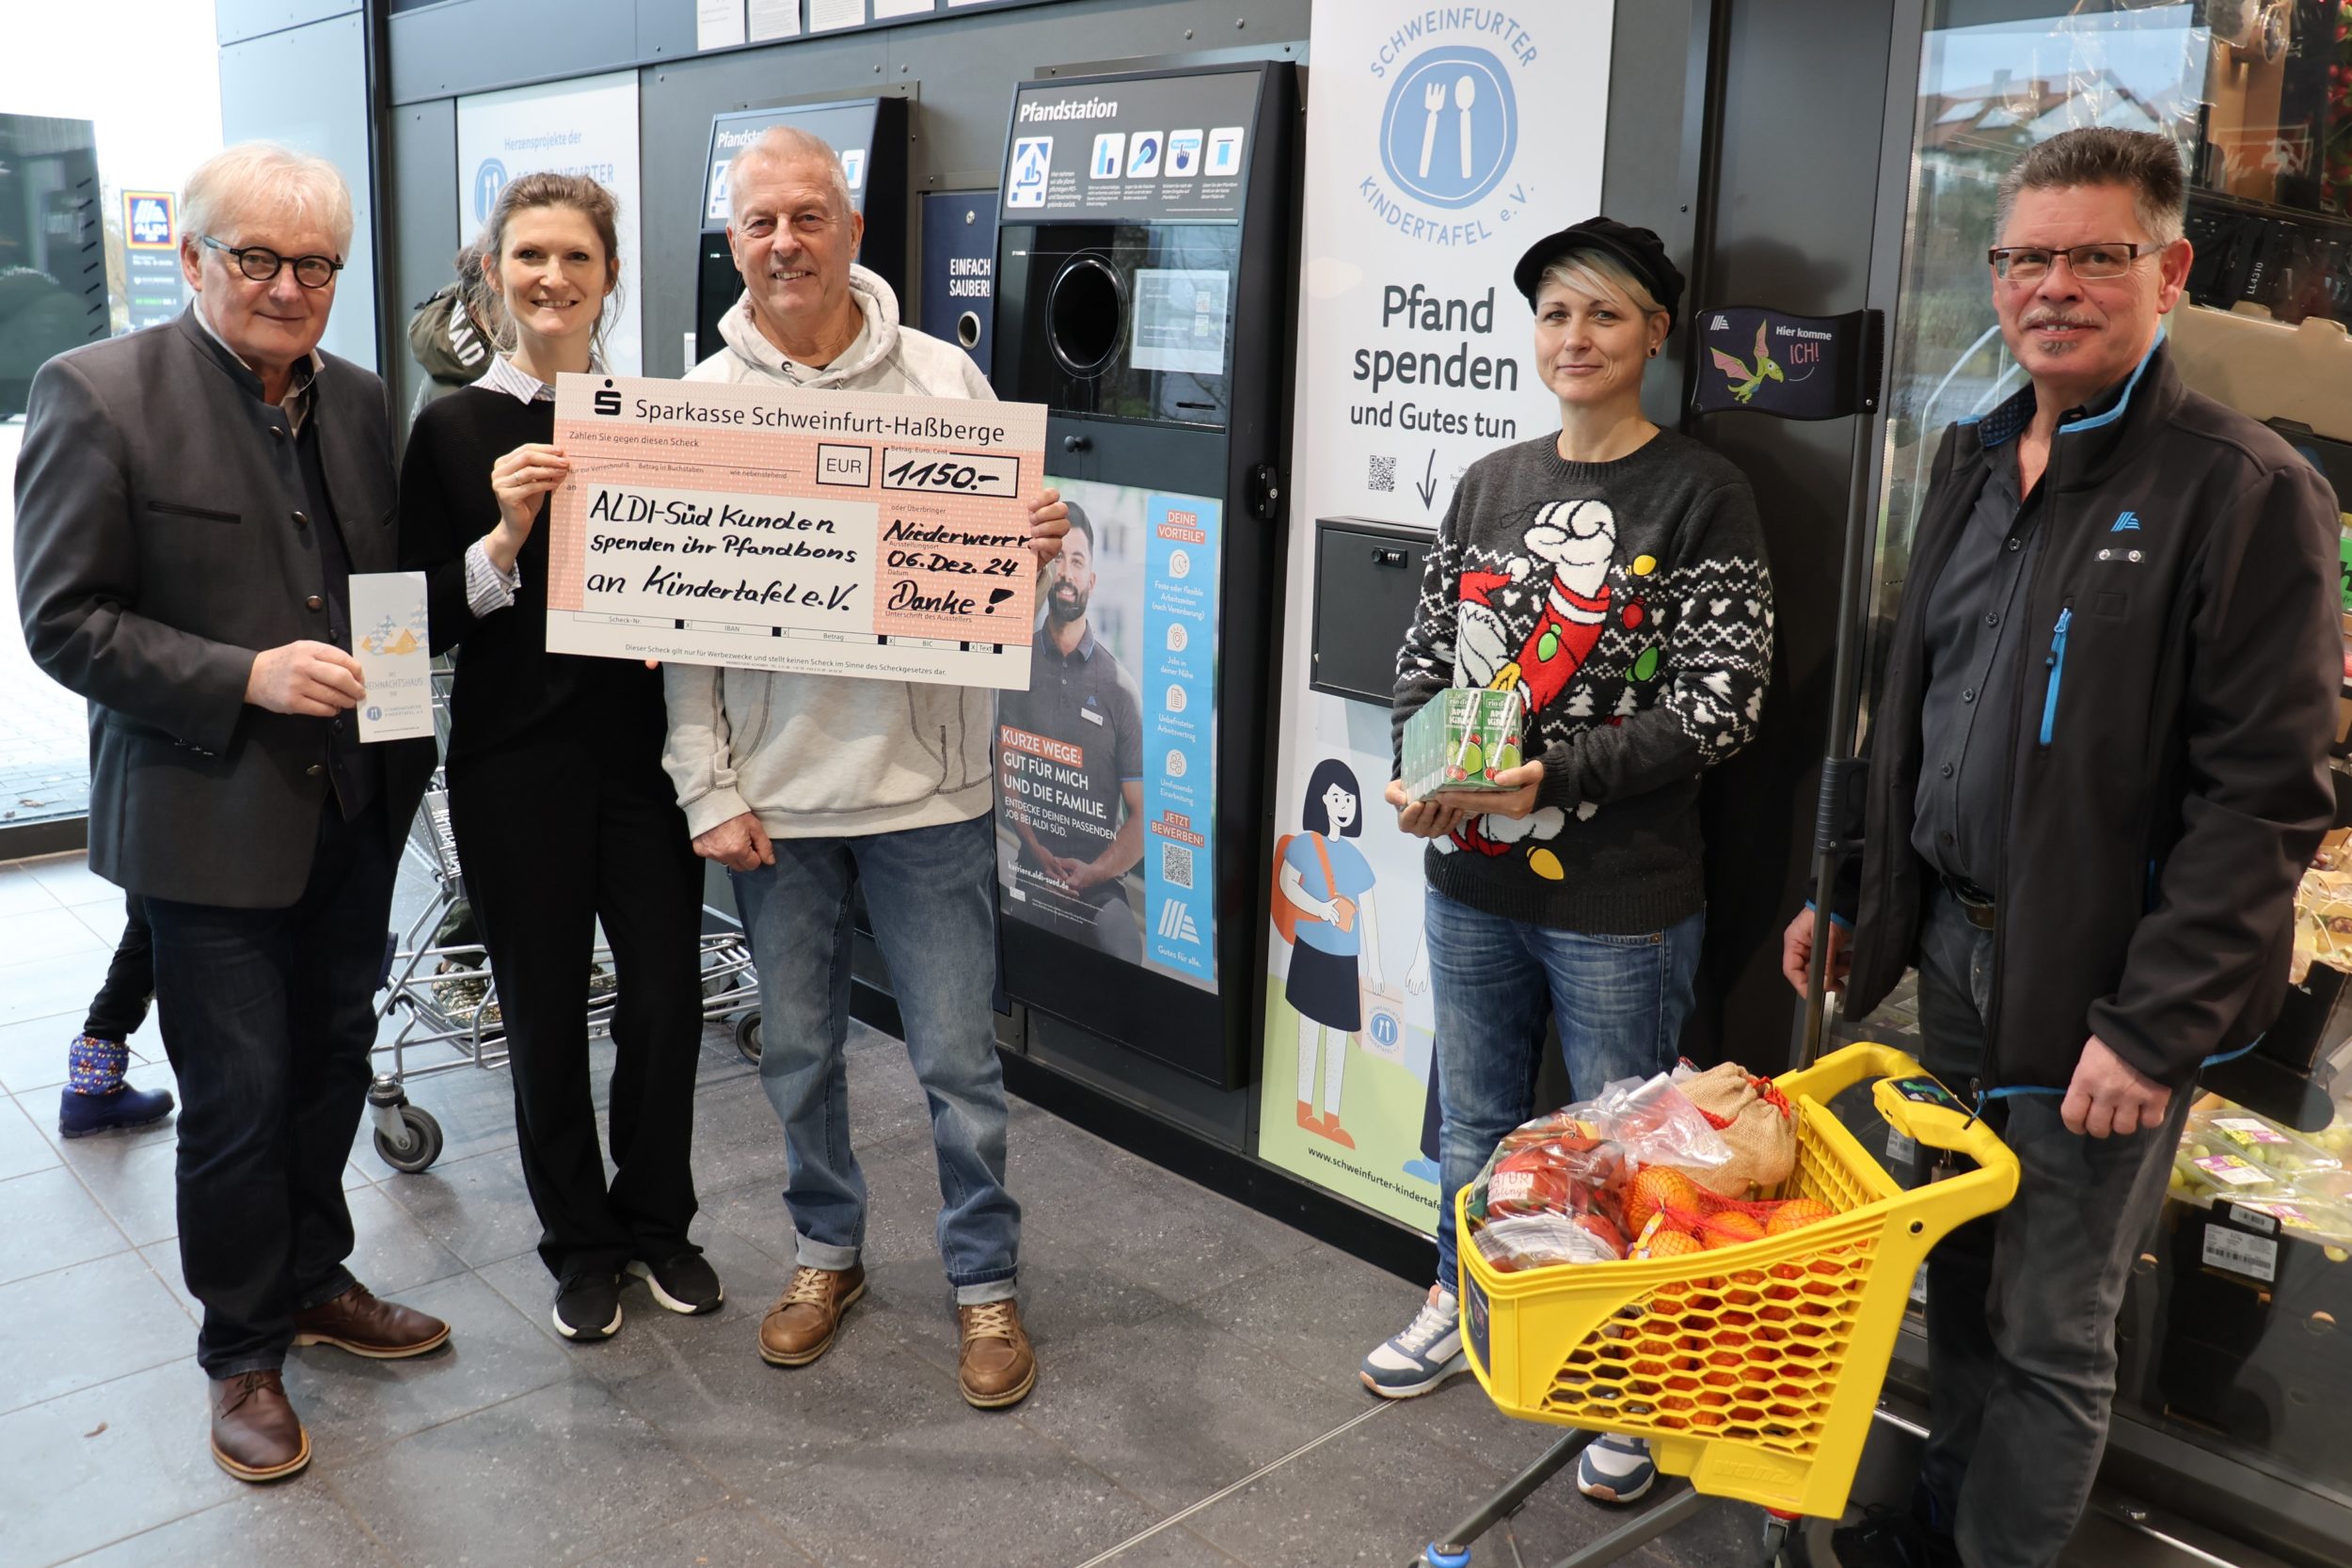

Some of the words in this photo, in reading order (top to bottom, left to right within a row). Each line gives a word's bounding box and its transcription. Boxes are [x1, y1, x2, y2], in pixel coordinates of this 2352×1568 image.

[1370, 8, 1537, 78] SCHWEINFURTER
[1020, 96, 1118, 122] Pfandstation
[504, 131, 566, 152] Herzensprojekte
[568, 130, 582, 145] der
[1359, 176, 1492, 246] KINDERTAFEL
[135, 223, 168, 236] ALDI
[950, 259, 991, 276] EINFACH
[2247, 261, 2264, 295] LL4310
[949, 279, 991, 297] SAUBER!
[1383, 284, 1495, 334] Pfand
[1776, 325, 1796, 337] Hier
[1797, 327, 1833, 341] komme
[1790, 342, 1820, 364] ICH!
[1353, 341, 1518, 393] spenden
[636, 399, 745, 425] Sparkasse
[752, 406, 1006, 446] Schweinfurt-Haßberge
[1351, 401, 1393, 428] und
[1400, 403, 1468, 436] Gutes
[1474, 412, 1517, 440] tun
[569, 431, 597, 441] Zahlen
[598, 433, 612, 442] Sie
[613, 436, 640, 445] gegen
[642, 436, 668, 445] diesen
[671, 437, 699, 448] Scheck
[638, 463, 659, 471] Betrag
[668, 464, 705, 473] Buchstaben
[742, 469, 787, 480] nebenstehend
[826, 458, 862, 474] EUR
[590, 490, 713, 528] ALDI-Süd
[720, 505, 836, 534] Kunden
[907, 505, 946, 515] Überbringer
[1168, 512, 1197, 527] DEINE
[682, 535, 717, 555] ihr
[722, 534, 858, 563] Pfandbons
[889, 541, 940, 550] Ausstellungsort
[587, 574, 628, 594] an
[643, 564, 799, 606] Kindertafel
[1154, 580, 1169, 592] Feste
[1170, 583, 1183, 594] oder
[1184, 585, 1204, 596] flexible
[1152, 601, 1167, 612] (nach
[1168, 604, 1205, 621] Vereinbarung)
[1161, 593, 1197, 607] Arbeitszeiten
[885, 611, 924, 620] Unterschrift
[937, 614, 972, 624] Ausstellers
[626, 644, 646, 653] Dieser
[647, 645, 671, 655] Scheck
[672, 647, 683, 657] gilt
[697, 648, 707, 657] für
[707, 651, 753, 661] Werbezwecke
[787, 657, 809, 665] keinen
[811, 658, 834, 667] Scheck
[846, 661, 865, 670] Sinne
[880, 664, 932, 675] Scheckgesetzes
[1168, 657, 1180, 666] Jobs
[1161, 666, 1178, 676] deiner
[1179, 669, 1194, 679] Nähe
[1159, 714, 1195, 729] Unbefristeter
[1157, 724, 1197, 743] Arbeitsvertrag
[1002, 728, 1041, 752] KURZE
[1042, 739, 1081, 765] WEGE:
[1004, 752, 1026, 771] GUT
[1029, 758, 1052, 780] FÜR
[1056, 768, 1089, 790] MICH
[1004, 773, 1030, 794] UND
[1033, 783, 1053, 802] DIE
[1056, 790, 1107, 819] FAMILIE.
[1161, 778, 1193, 794] Umfassende
[1160, 789, 1194, 807] Einarbeitung
[1005, 797, 1041, 816] ENTDECKE
[1042, 809, 1071, 826] DEINEN
[1073, 818, 1117, 841] PASSENDEN
[1006, 809, 1019, 820] JOB
[1021, 814, 1031, 826] BEI
[1032, 818, 1048, 831] ALDI
[1050, 823, 1068, 837] SÜD.
[1165, 812, 1189, 828] JETZT
[1152, 822, 1203, 847] BEWERBEN!
[1009, 861, 1069, 891] karriere.aldi-sued.de
[1158, 945, 1177, 958] Gutes
[1178, 952, 1186, 962] für
[1188, 957, 1201, 968] alle.
[1308, 1147, 1441, 1212] www.schweinfurter-kindertafe
